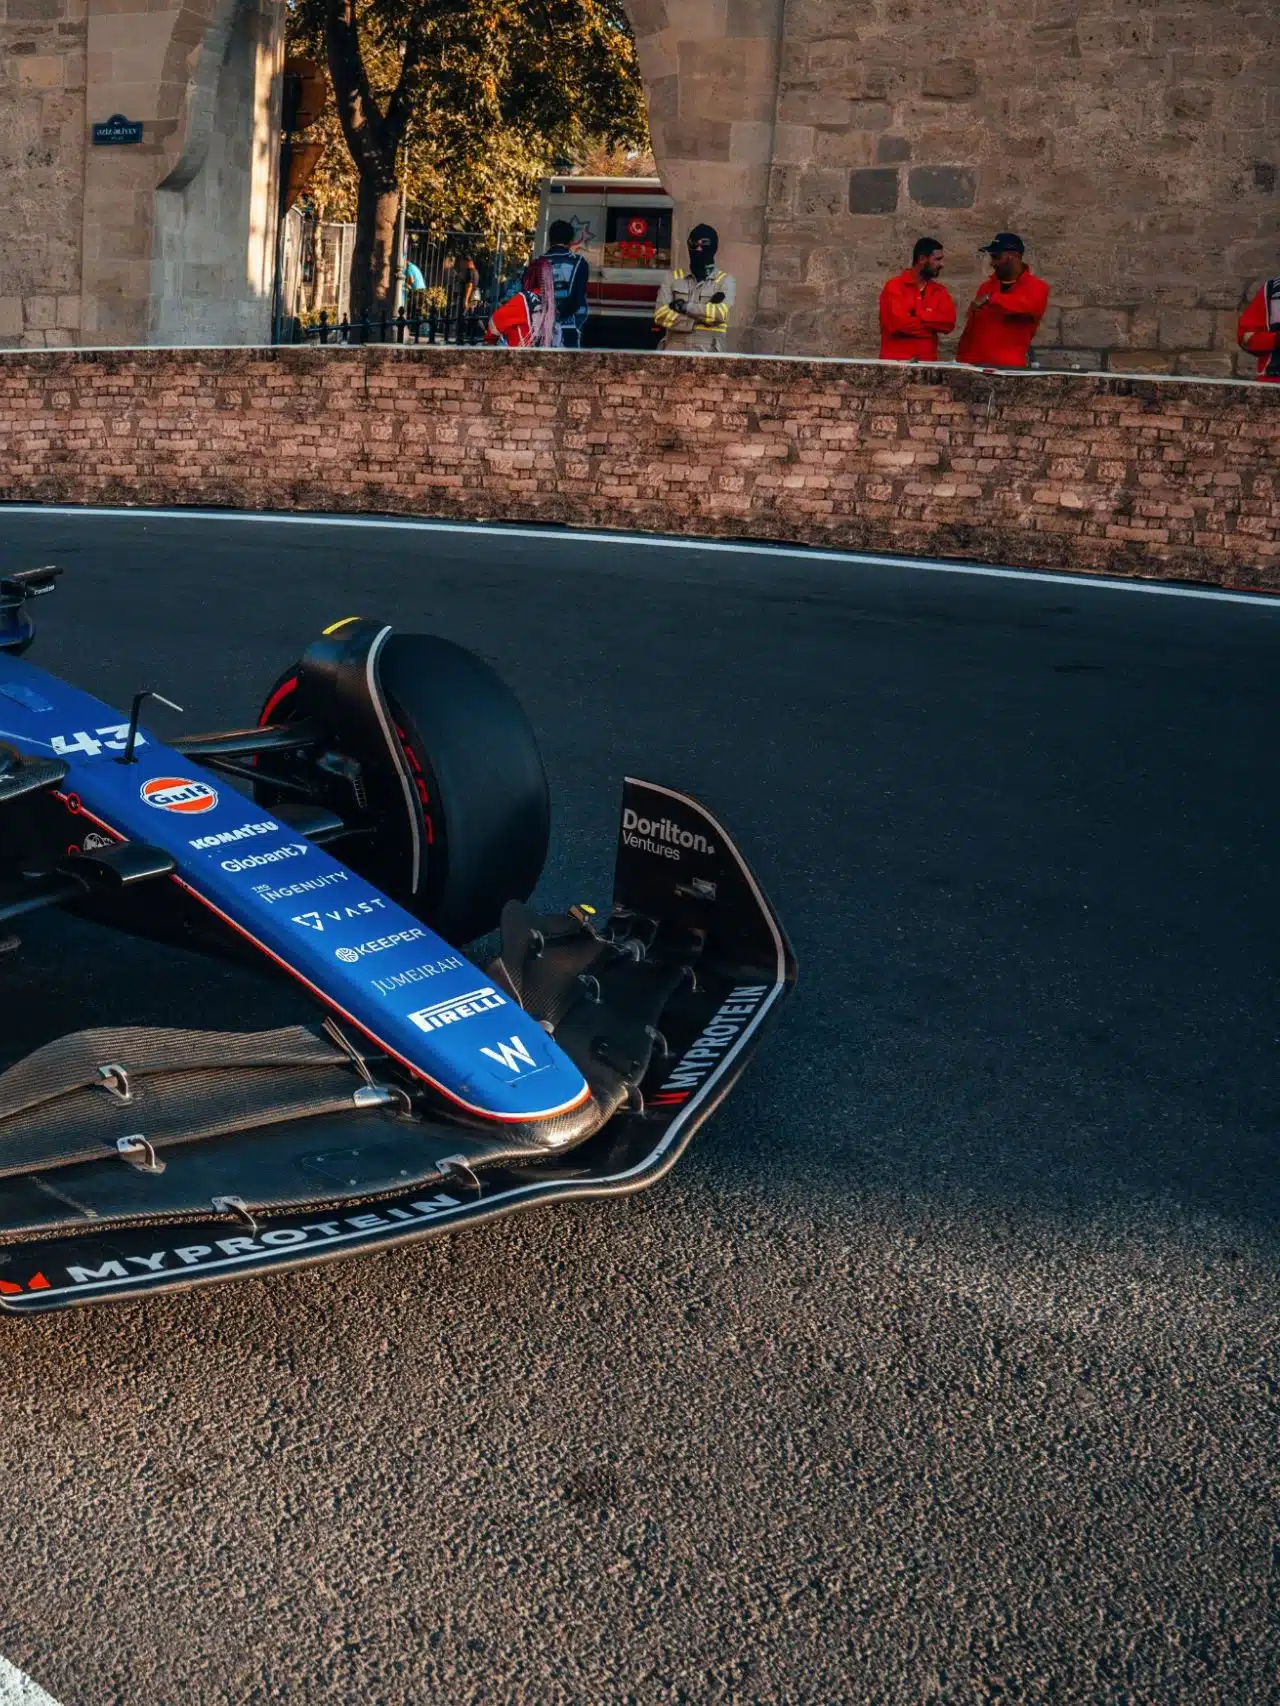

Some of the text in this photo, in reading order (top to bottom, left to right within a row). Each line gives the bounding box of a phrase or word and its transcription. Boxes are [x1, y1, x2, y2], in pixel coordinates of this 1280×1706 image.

[50, 722, 150, 756] 43
[148, 785, 210, 806] Gulf
[188, 820, 279, 850] KOMATSU
[622, 829, 681, 861] Ventures
[325, 898, 387, 921] VAST
[355, 928, 426, 957] KEEPER
[407, 987, 508, 1033] PIRELLI
[659, 985, 768, 1090] MYPROTEIN
[65, 1193, 462, 1283] MYPROTEIN
